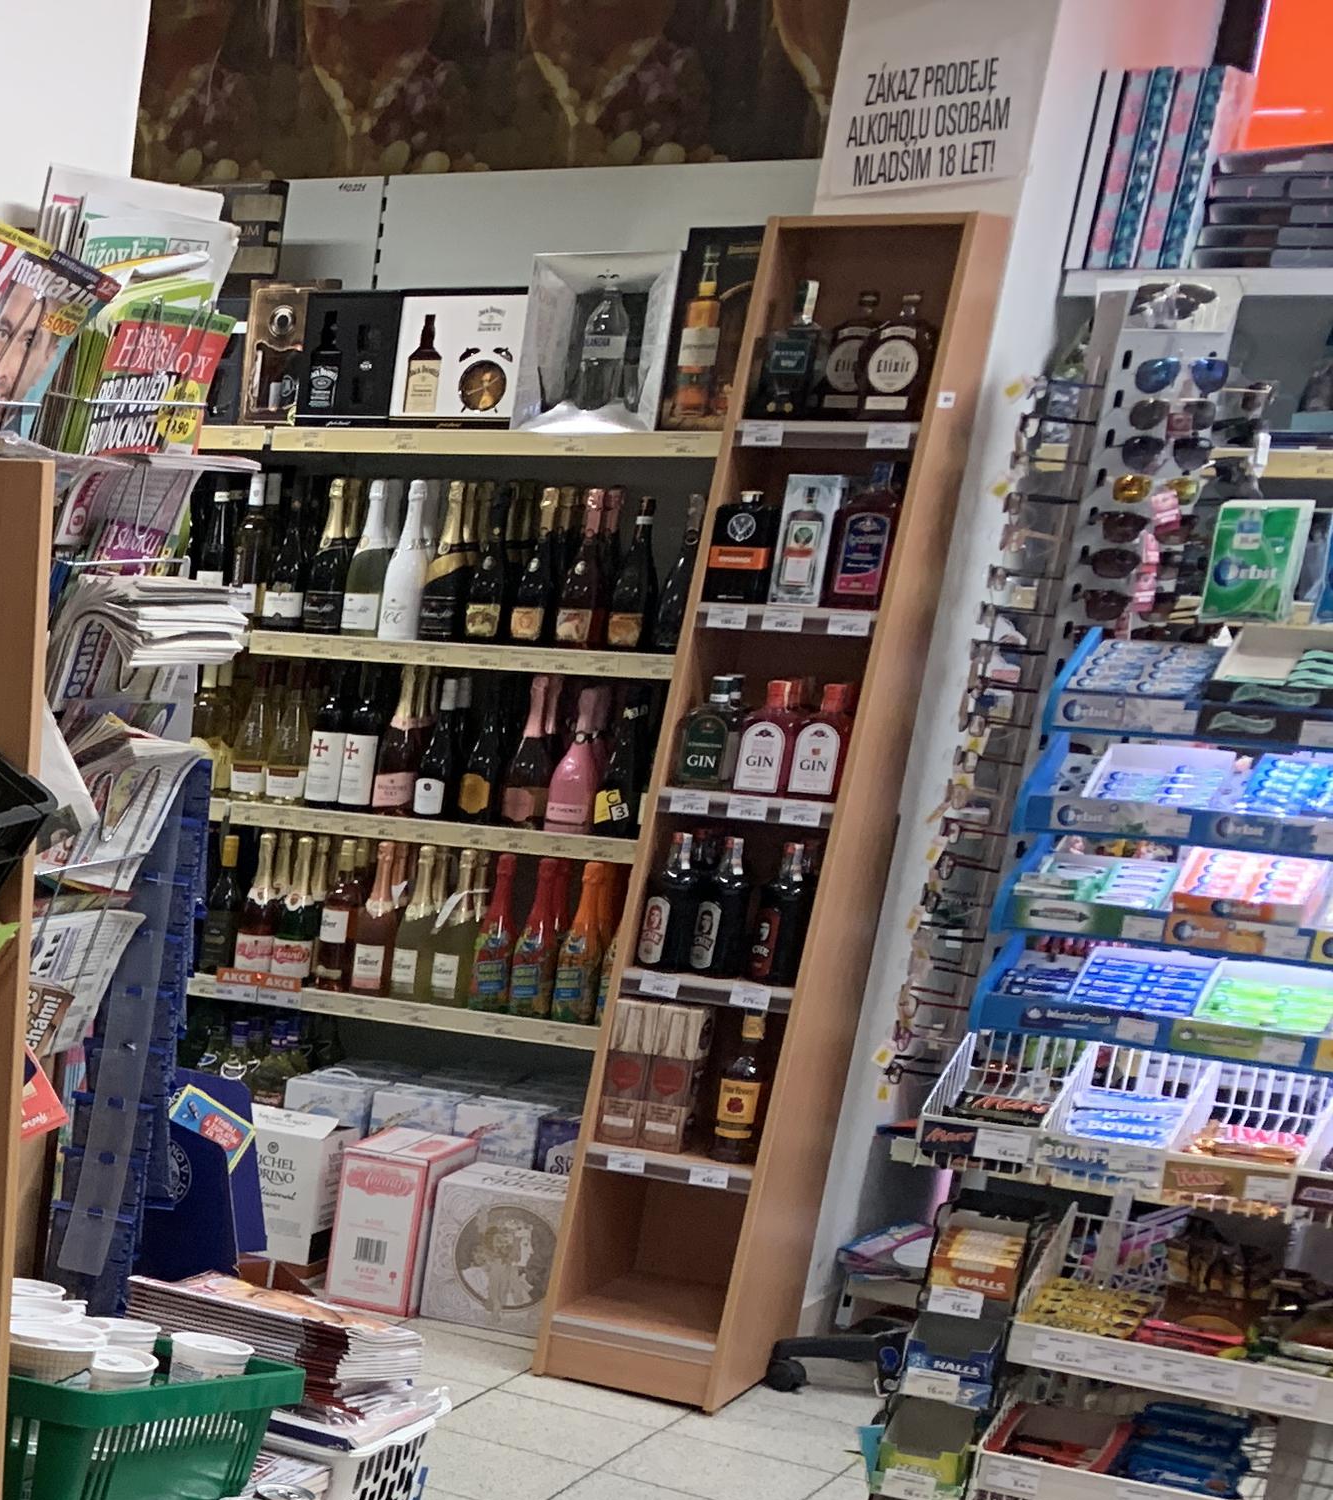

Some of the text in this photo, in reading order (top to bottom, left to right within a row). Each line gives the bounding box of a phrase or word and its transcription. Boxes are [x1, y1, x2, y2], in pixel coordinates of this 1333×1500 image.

[865, 57, 999, 106] ZÁKAZ PRODEJE
[847, 92, 1011, 148] ALKOHOLU OSOBÁM
[853, 139, 996, 187] MLADŠÍM 18 LET!
[875, 356, 911, 375] Elixir
[686, 753, 716, 769] GIN
[745, 754, 775, 769] GIN
[799, 758, 828, 772] GIN
[222, 969, 252, 984] AKCE
[265, 974, 296, 990] AKCE
[256, 1168, 296, 1185] ORINO
[957, 1273, 1007, 1294] HALLS
[933, 1358, 981, 1378] HALLS
